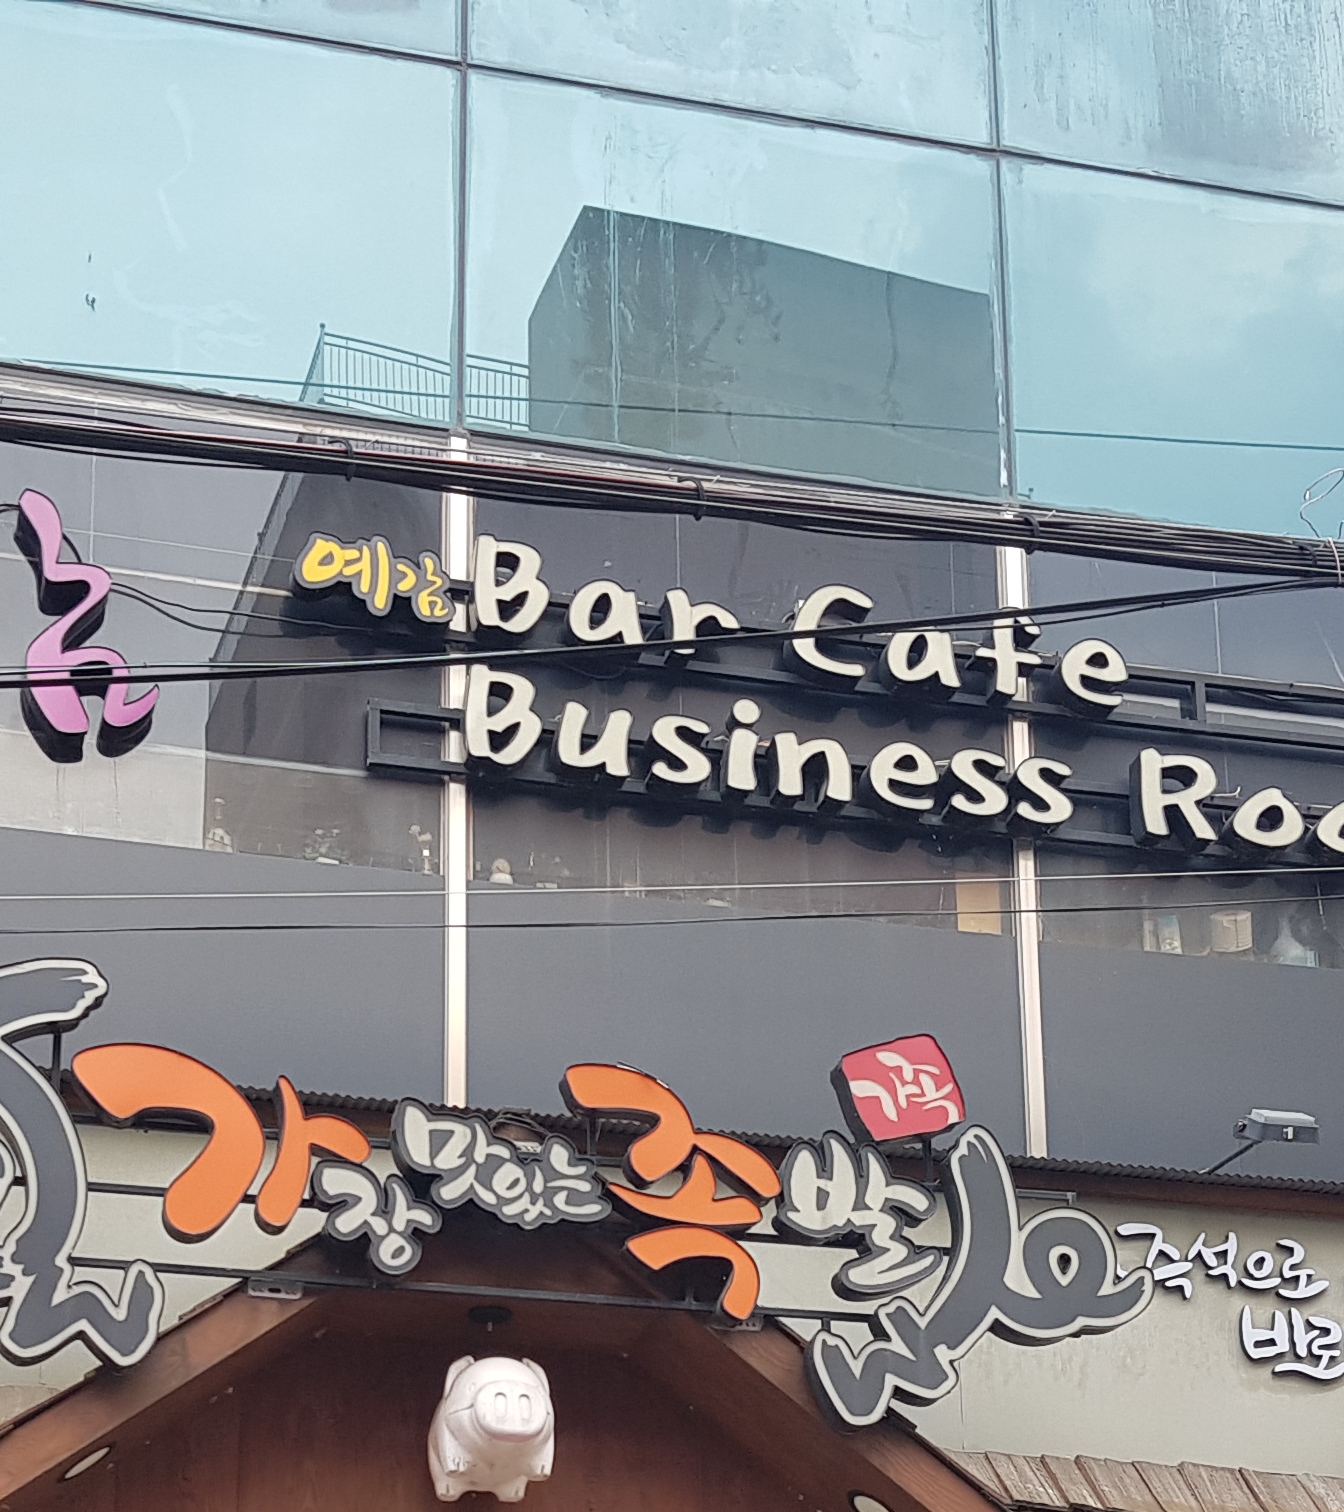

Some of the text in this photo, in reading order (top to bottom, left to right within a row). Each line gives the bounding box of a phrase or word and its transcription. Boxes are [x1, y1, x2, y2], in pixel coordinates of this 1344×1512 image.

[471, 535, 1130, 711] Bar Cafe
[463, 664, 1074, 825] Business
[564, 1063, 937, 1321] 족발
[1116, 1222, 1329, 1299] 즉석으로
